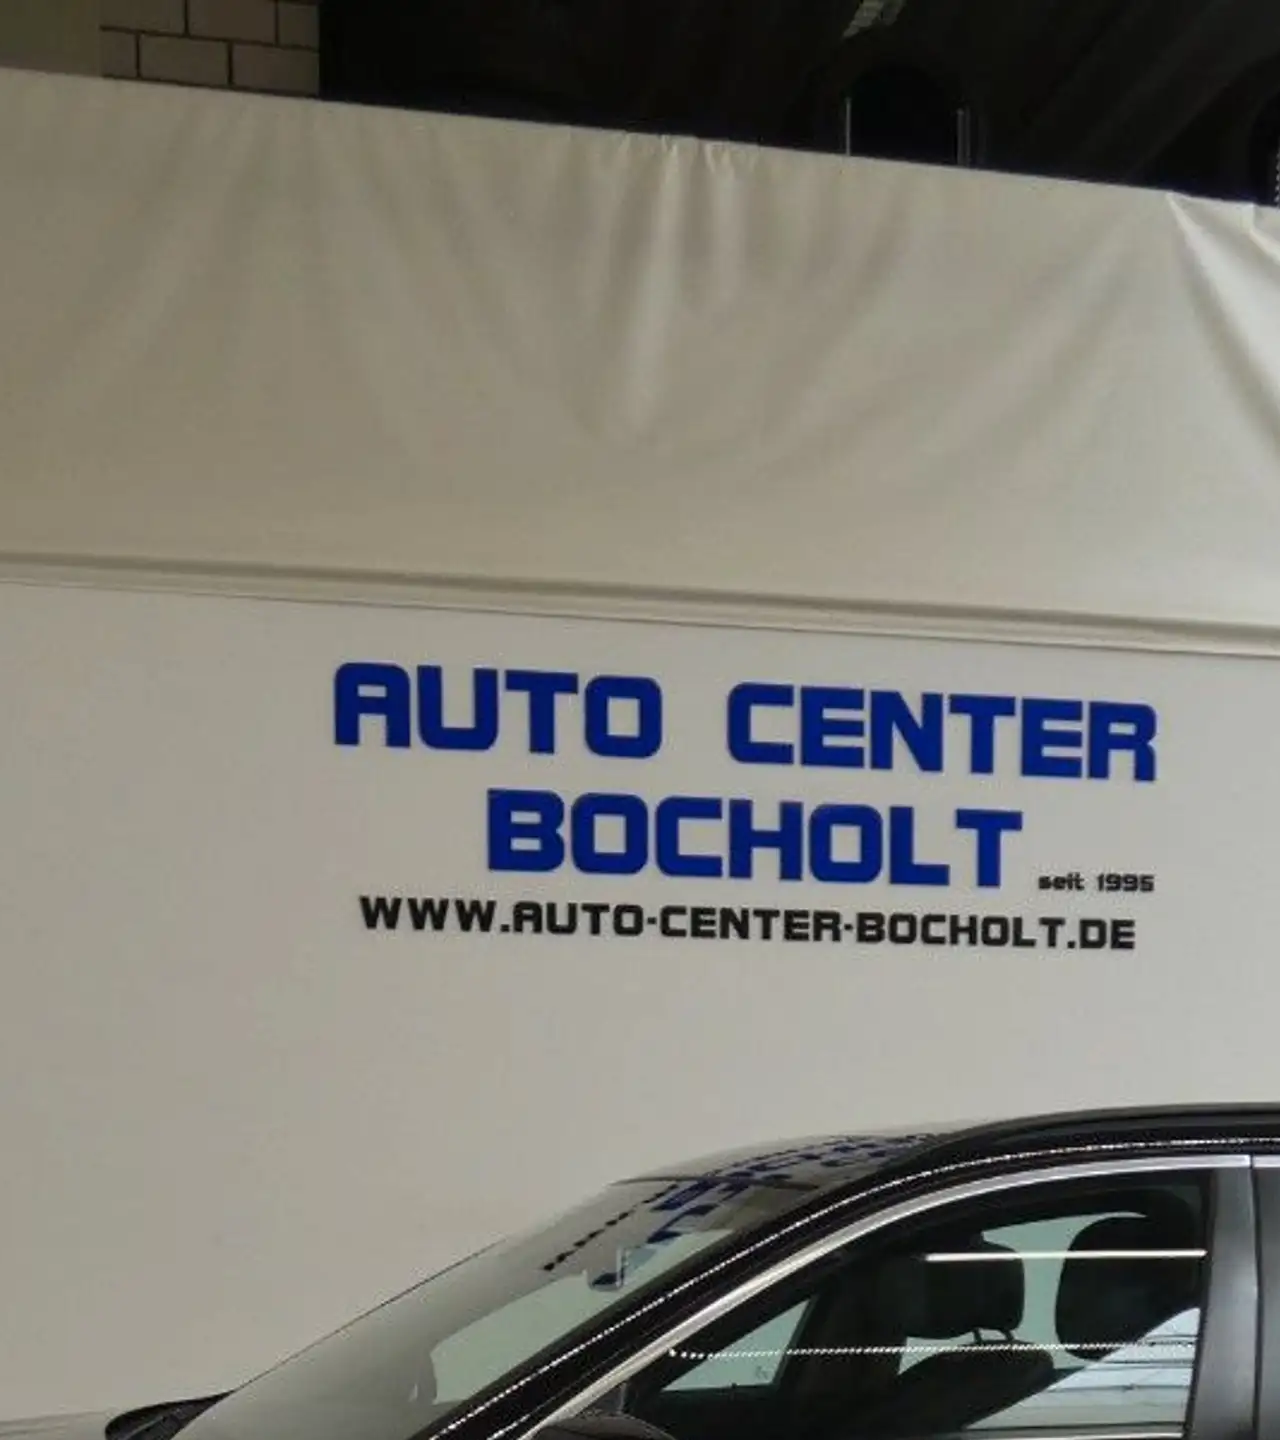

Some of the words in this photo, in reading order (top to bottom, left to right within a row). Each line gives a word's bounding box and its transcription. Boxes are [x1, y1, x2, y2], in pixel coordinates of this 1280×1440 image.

[333, 662, 663, 759] AUTO
[727, 682, 1159, 785] CENTER
[487, 788, 1024, 888] BOCHOLT
[1038, 871, 1086, 891] seit
[1097, 872, 1156, 892] 1995
[358, 895, 1137, 950] WWW.AUTO-CENTER-BOCHOLT.DE
